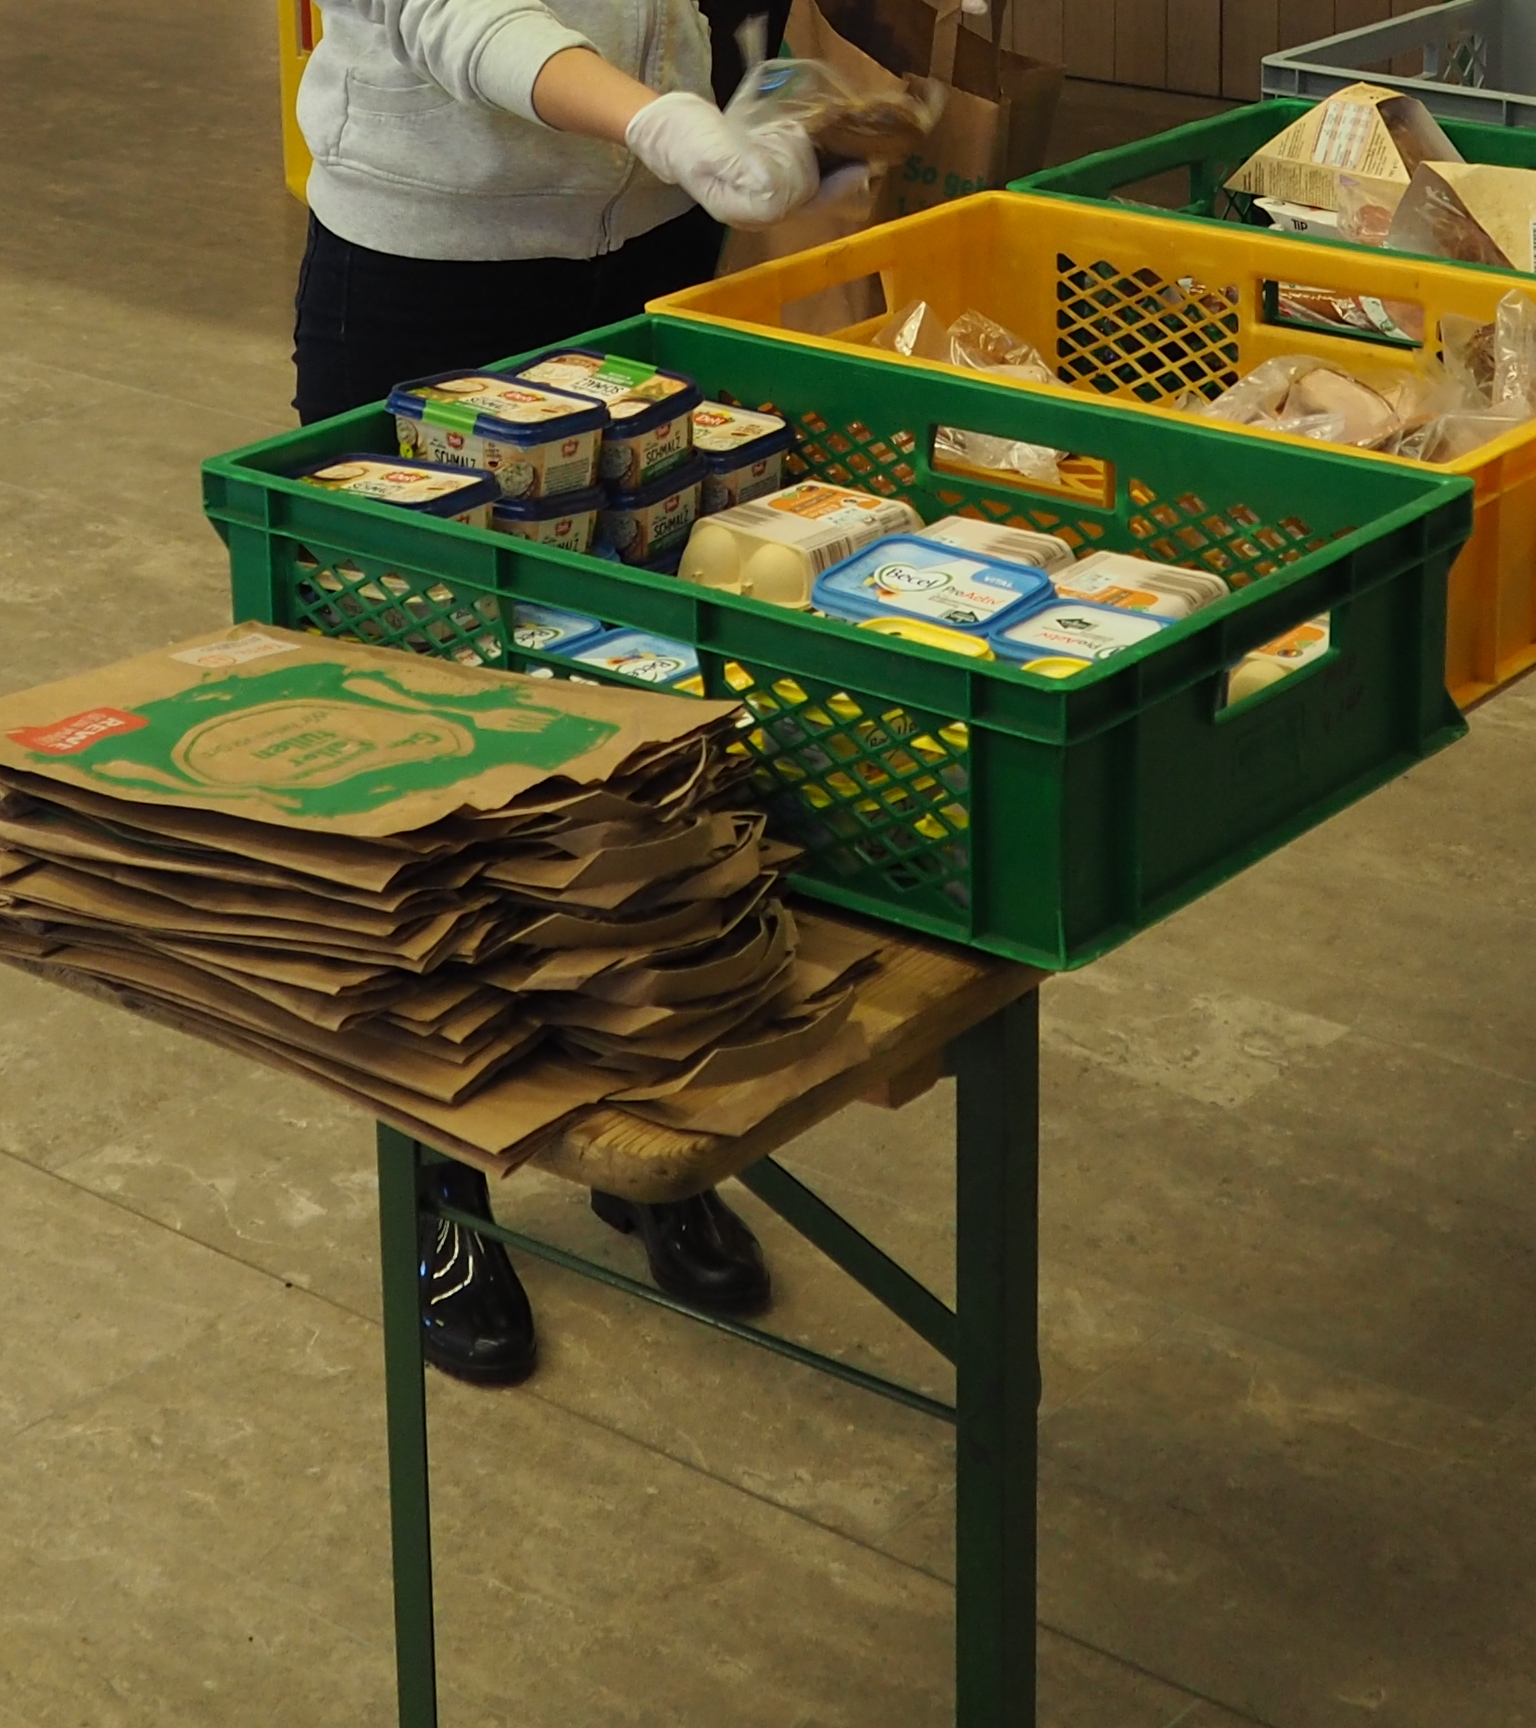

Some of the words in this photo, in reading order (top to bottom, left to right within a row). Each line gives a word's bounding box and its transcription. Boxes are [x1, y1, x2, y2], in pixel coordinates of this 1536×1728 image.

[902, 154, 938, 185] So
[645, 435, 682, 466] SCHMALZ
[652, 509, 690, 539] SCHMALZ
[885, 568, 941, 592] Becel
[984, 575, 1013, 589] VITAL
[943, 585, 1005, 607] ProActiv
[47, 716, 126, 752] REWE
